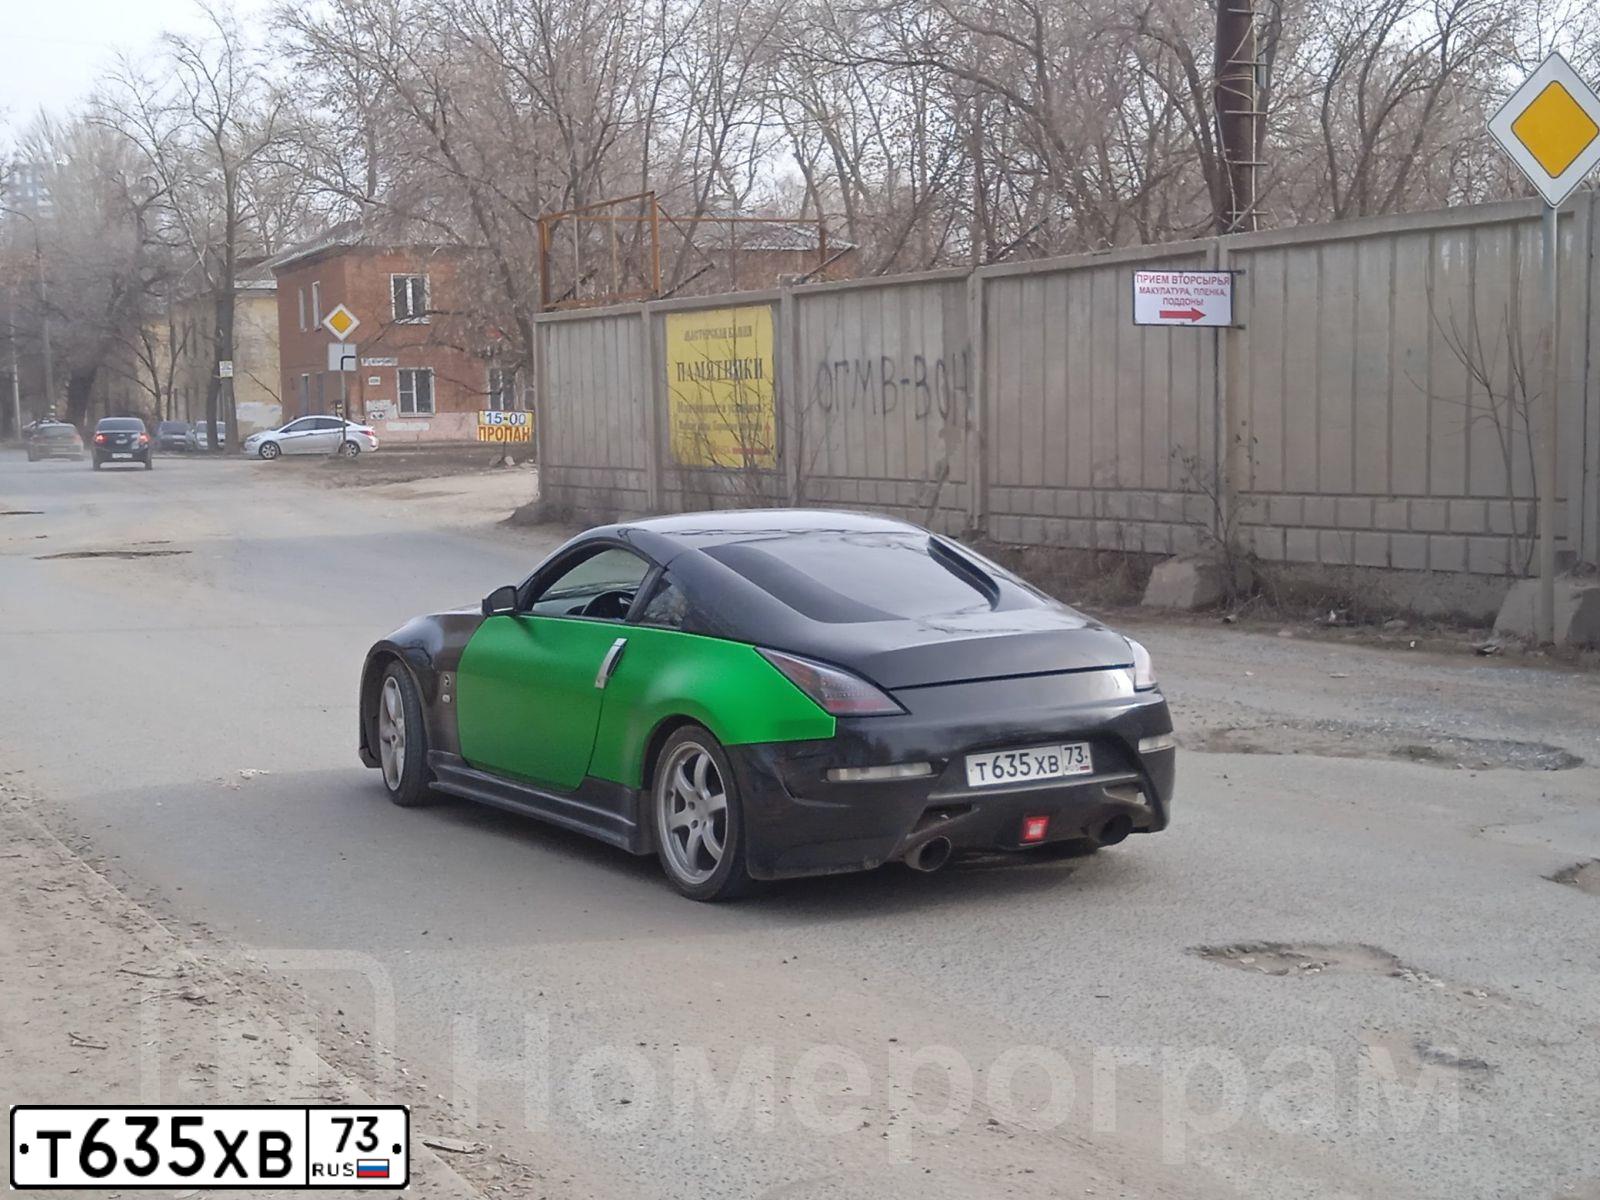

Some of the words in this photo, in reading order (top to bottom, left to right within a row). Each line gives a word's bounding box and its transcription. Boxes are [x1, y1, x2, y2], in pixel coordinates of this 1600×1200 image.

[1137, 275, 1169, 284] ПРИЕМ
[1172, 276, 1230, 286] ВТОРСЫРЬЯ
[1139, 287, 1192, 296] МАКУЛАТУРА,
[676, 358, 763, 382] ПАМЯТНИКИ
[487, 412, 526, 425] 15-00
[478, 426, 530, 442] ПРОПАН
[1064, 746, 1084, 765] 73
